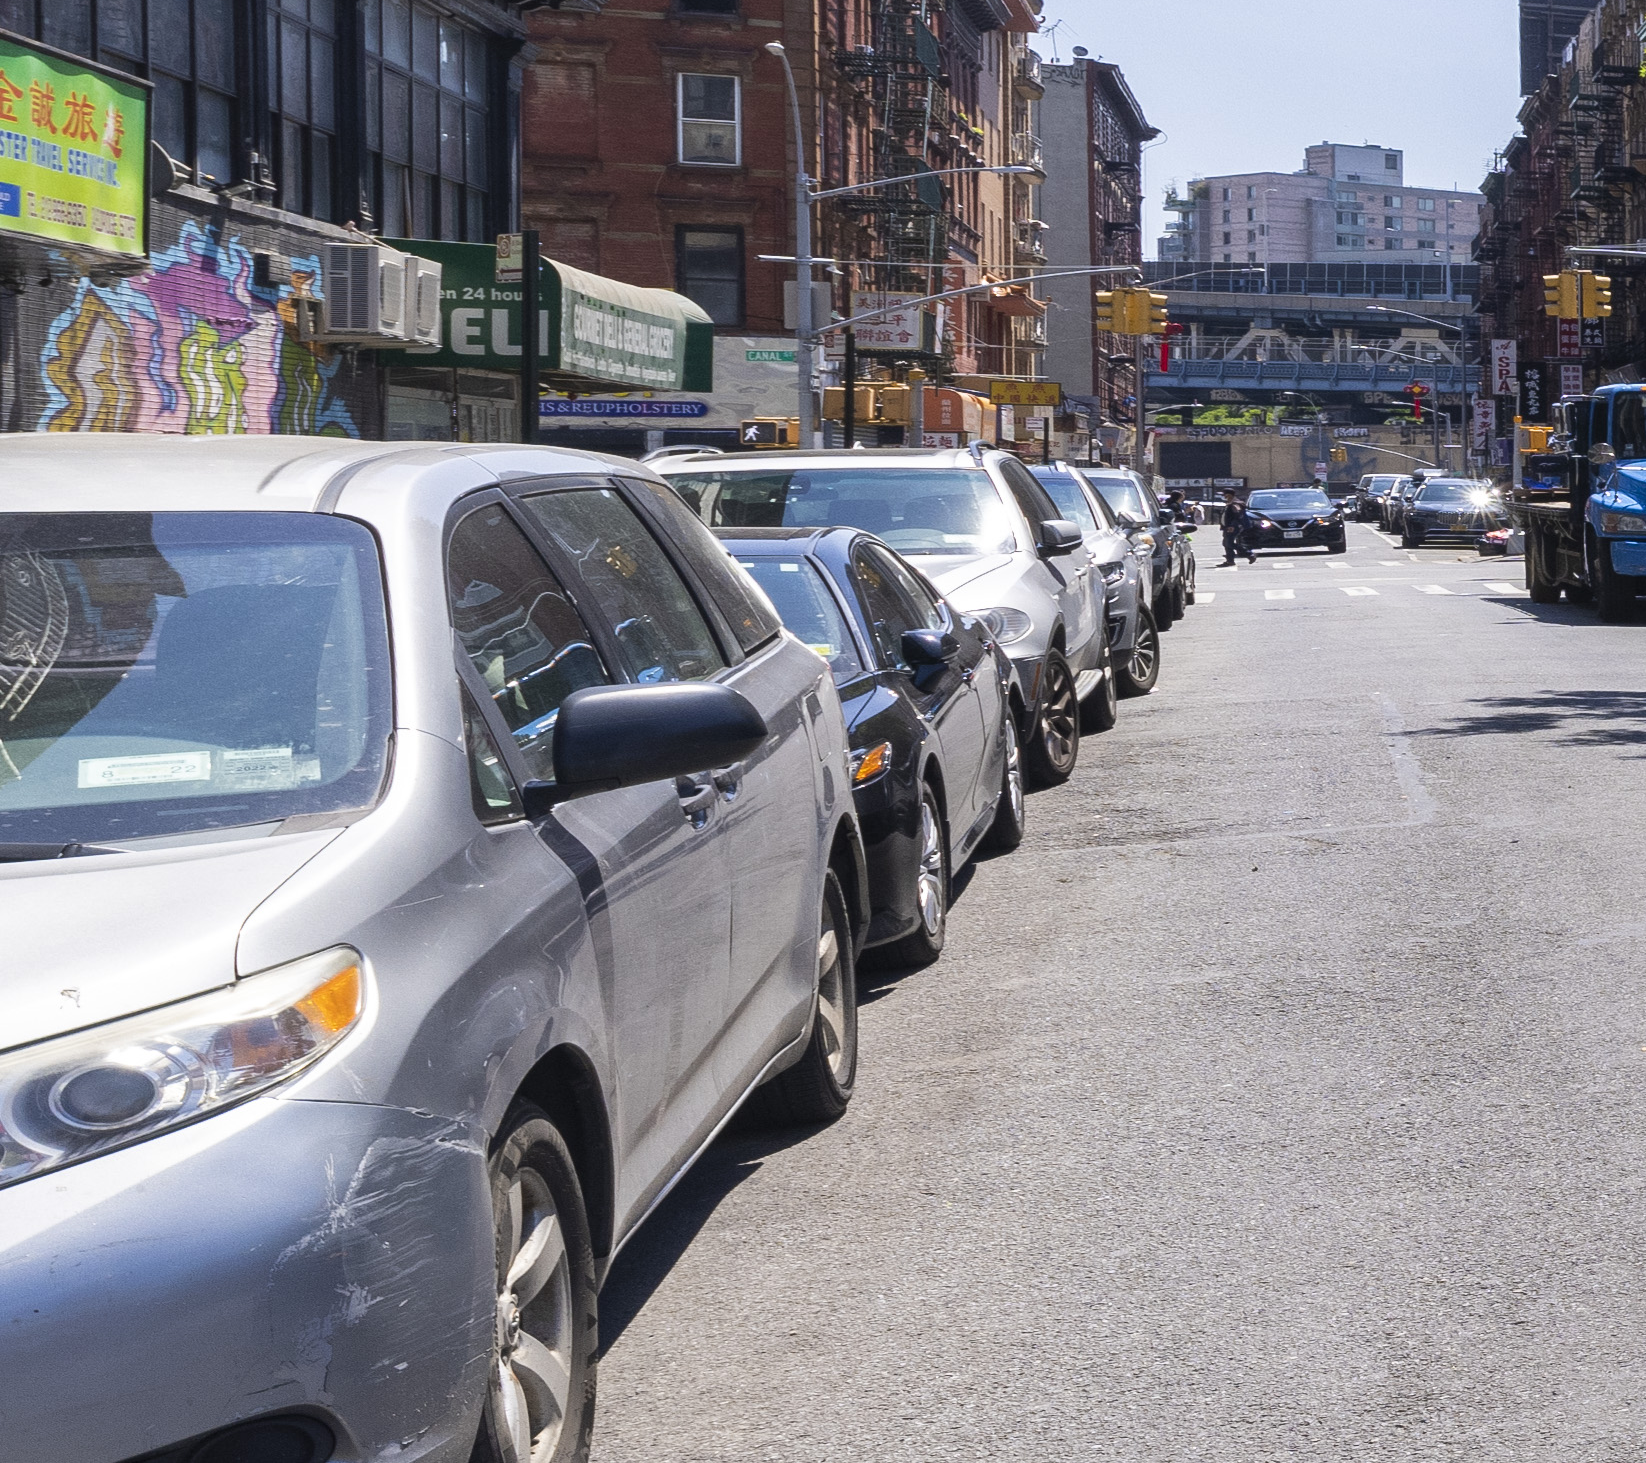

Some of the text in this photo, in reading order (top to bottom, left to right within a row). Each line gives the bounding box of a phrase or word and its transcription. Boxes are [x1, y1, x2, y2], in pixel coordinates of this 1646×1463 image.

[31, 136, 64, 173] TRAVEL
[462, 287, 486, 300] 24
[405, 307, 549, 357] ELI
[748, 351, 782, 361] CANAL
[1497, 356, 1511, 392] SPA
[557, 402, 571, 413] &
[571, 403, 702, 414] REUPHOLSTERY
[101, 764, 197, 779] 8 22
[235, 764, 267, 772] 2022
